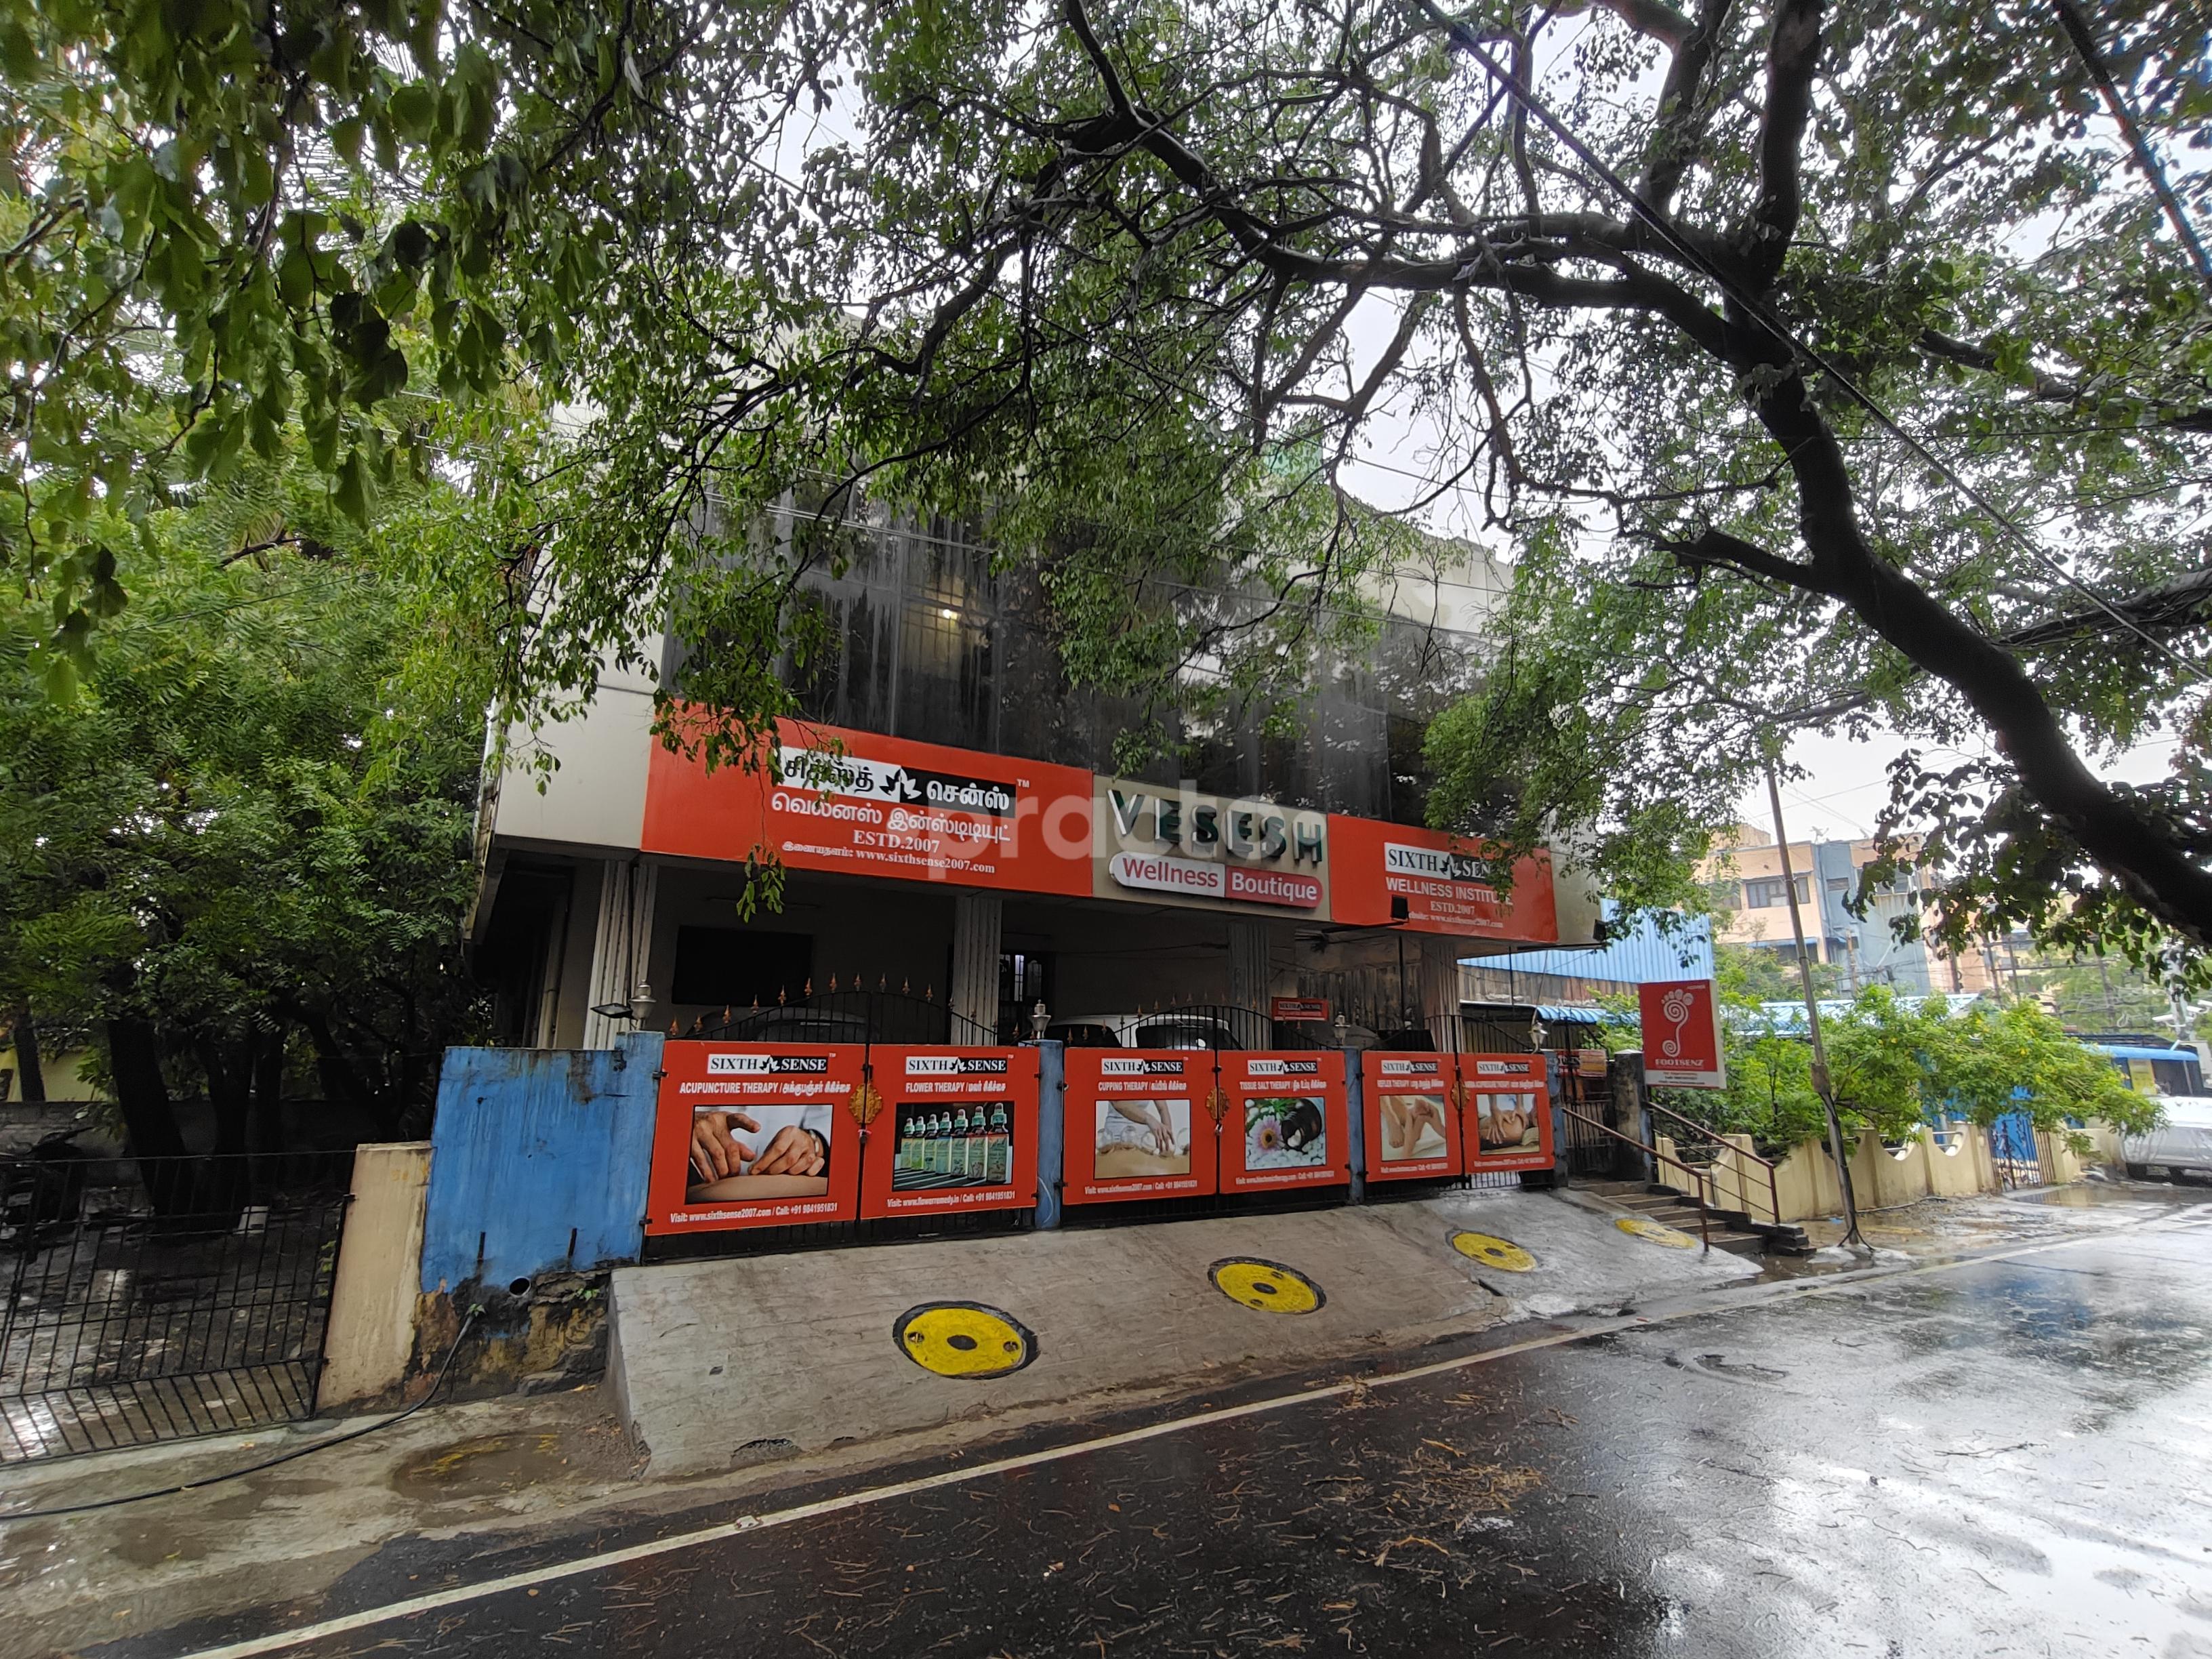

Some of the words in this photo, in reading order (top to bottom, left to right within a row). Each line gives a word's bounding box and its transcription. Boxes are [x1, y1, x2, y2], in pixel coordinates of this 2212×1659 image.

[926, 781, 1009, 810] சென்ஸ்
[1107, 790, 1322, 863] VESESH
[853, 830, 940, 853] ESTD.2007
[856, 848, 995, 874] www.sixthsense2007.com
[1388, 848, 1437, 872] SIXTH
[1122, 858, 1218, 888] Wellness
[1231, 872, 1318, 902] Boutique
[1386, 876, 1453, 898] WELLNESS
[1430, 901, 1475, 915] ESTD.2007
[711, 1058, 758, 1069] SIXTH
[781, 1059, 827, 1071] SENSE
[909, 1060, 947, 1070] SIXTH
[968, 1060, 1006, 1071] SENSE
[1104, 1062, 1135, 1071] SIXTH
[1151, 1062, 1183, 1071] SENSE
[1250, 1063, 1276, 1071] SIXTH
[1290, 1063, 1316, 1071] SENSE
[1383, 1063, 1405, 1071] SIXTH
[1416, 1063, 1437, 1071] SENSE
[680, 1082, 741, 1094] ACUPUNCTURE
[742, 1082, 779, 1093] THERAPY
[905, 1082, 933, 1092] FLOWER
[935, 1082, 965, 1092] THERAPY
[1098, 1082, 1123, 1091] CUPPING
[1124, 1082, 1148, 1090] THERAPY
[1257, 1082, 1269, 1090] SALT
[1270, 1081, 1290, 1089] THERAPY
[887, 1198, 901, 1207] Visit:
[962, 1193, 975, 1202] Call:
[975, 1192, 985, 1202] +91
[670, 1212, 687, 1223] Visit:
[689, 1208, 771, 1221] www.sixthsense2007.com
[775, 1206, 790, 1216] Call:
[791, 1204, 801, 1214] +91
